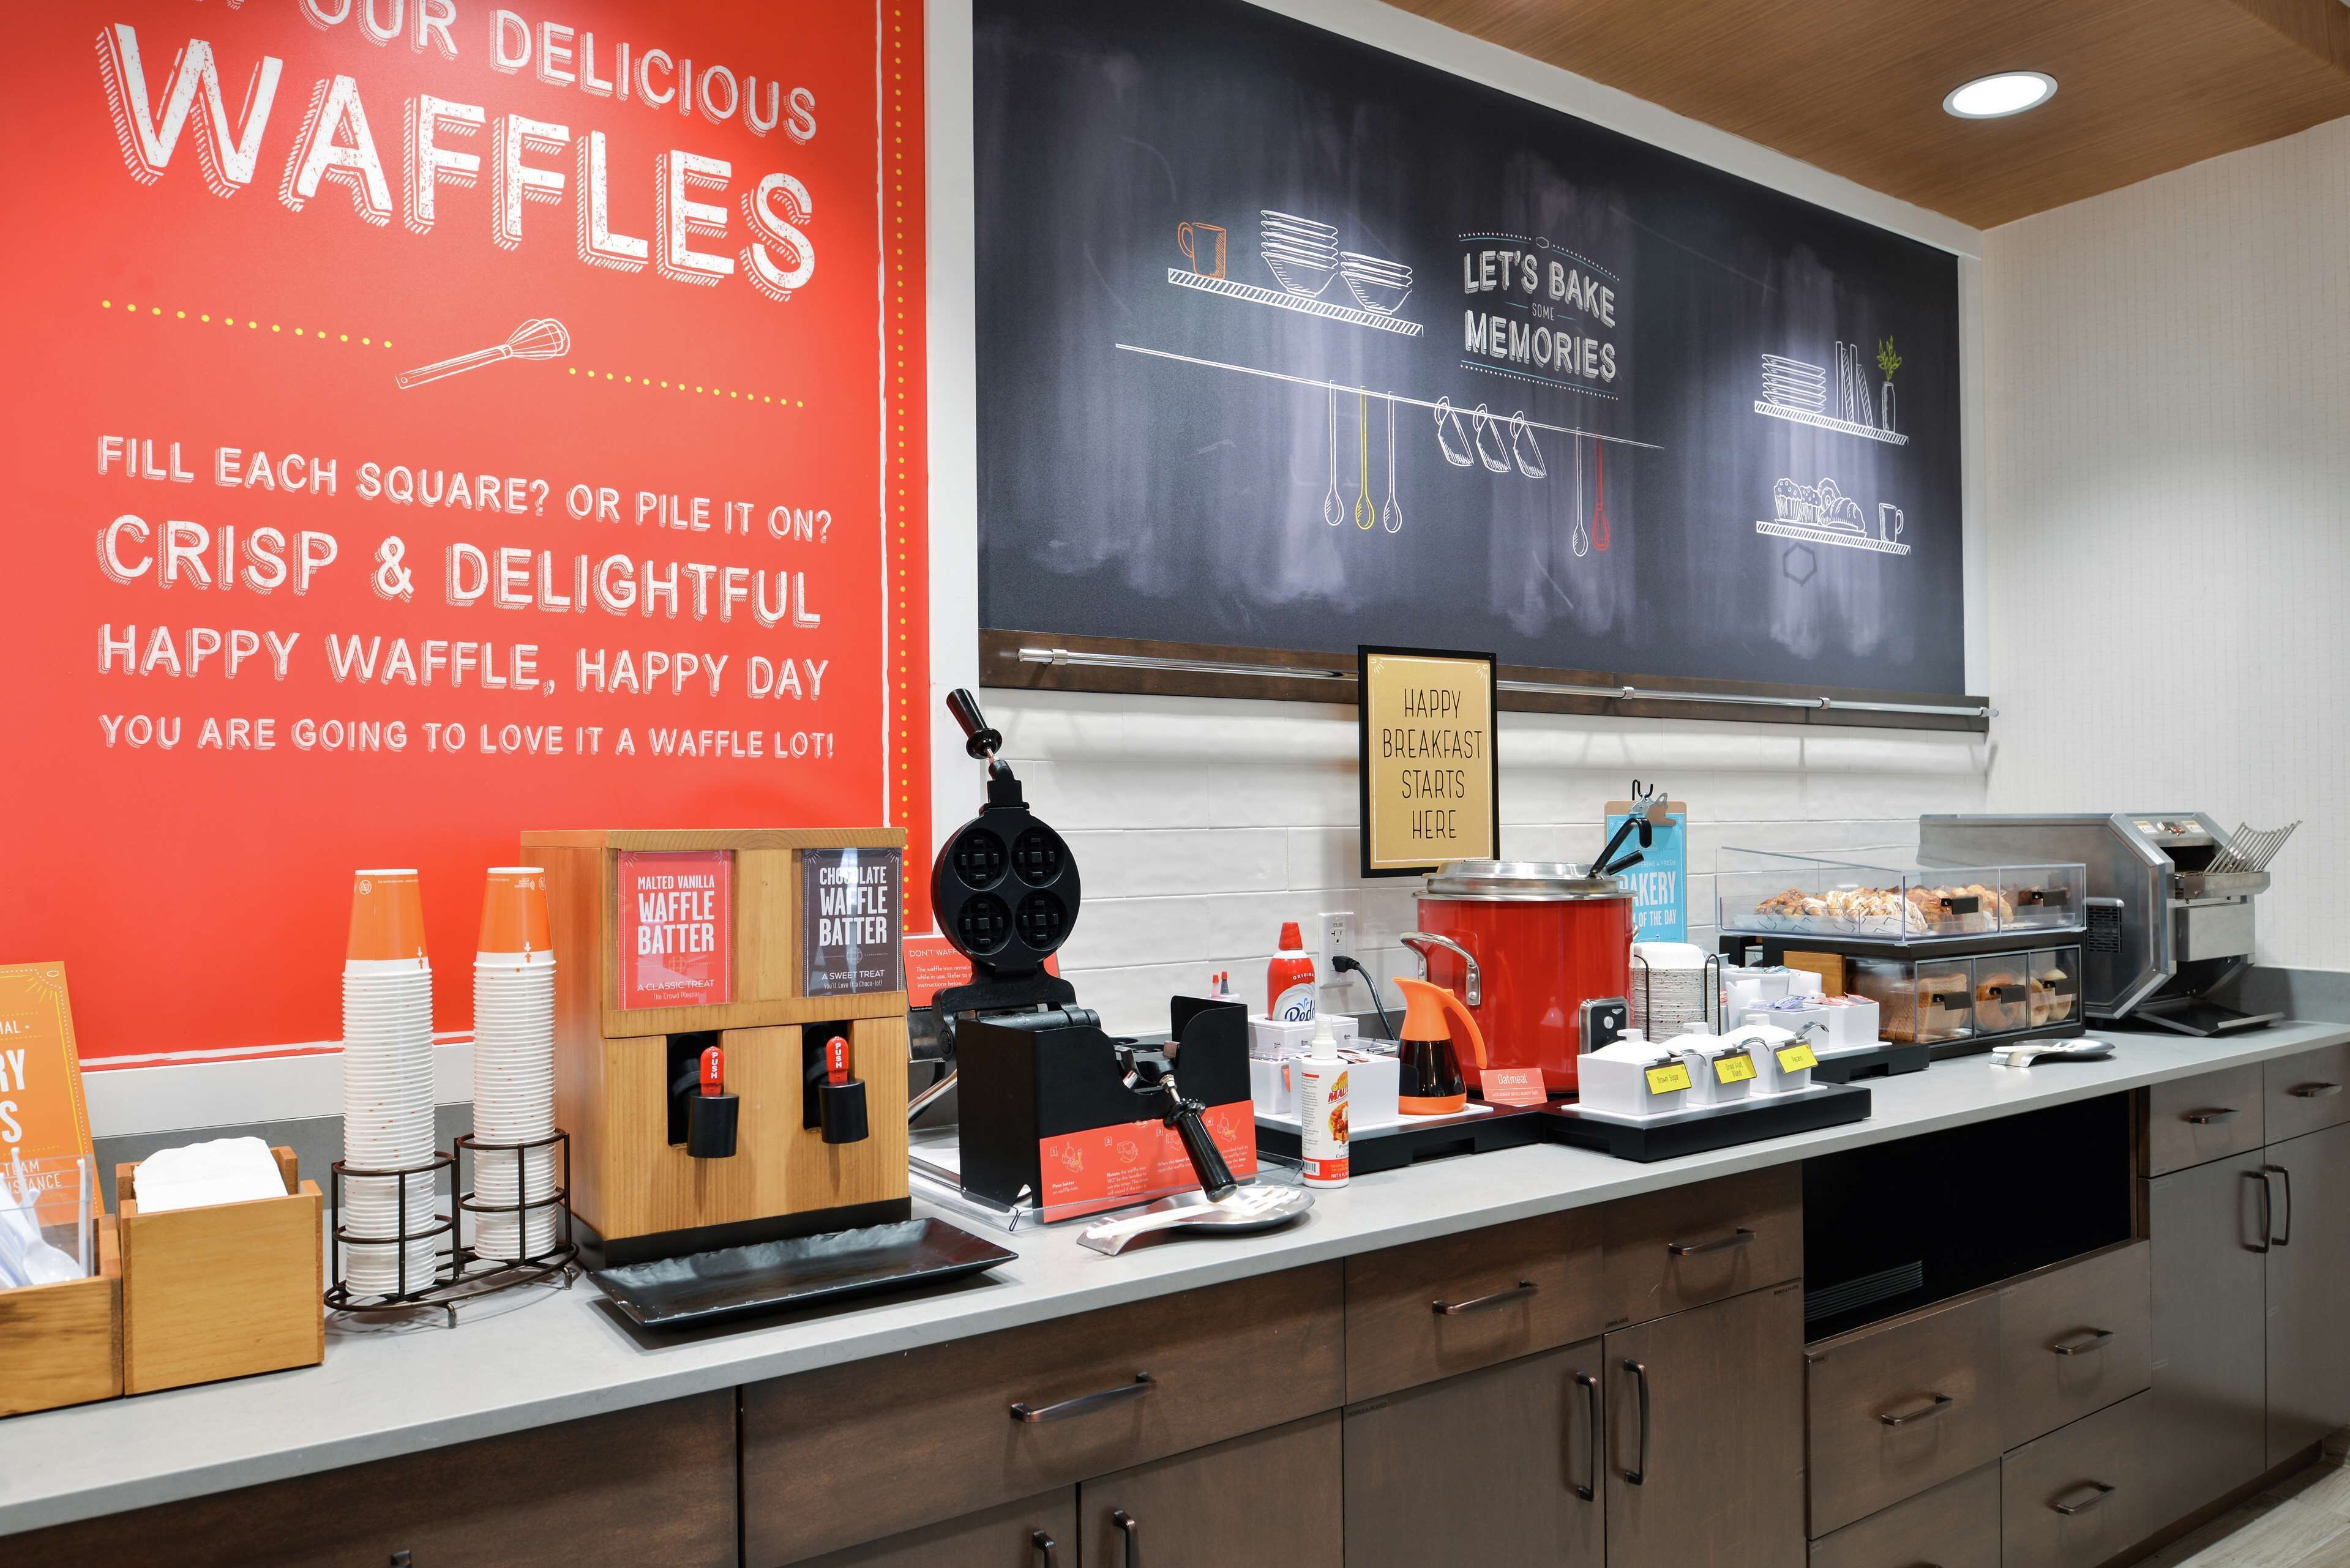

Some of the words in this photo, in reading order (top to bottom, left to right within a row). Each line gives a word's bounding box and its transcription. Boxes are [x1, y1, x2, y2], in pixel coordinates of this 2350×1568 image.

[490, 10, 816, 144] DELICIOUS
[96, 23, 816, 301] WAFFLES
[1464, 250, 1538, 294] LET'S
[1549, 261, 1615, 328] BAKE
[1532, 303, 1555, 321] SOME
[1465, 310, 1616, 382] MEMORIES
[98, 435, 194, 482] FILL
[215, 447, 336, 495] EACH
[356, 462, 549, 515] SQUARE?
[566, 484, 620, 523] OR
[636, 491, 710, 531] PILE
[725, 501, 754, 535] IT
[768, 506, 831, 543] ON?
[97, 515, 337, 596] CRISP
[372, 536, 414, 602] &
[446, 543, 820, 629] DELIGHTFUL
[98, 624, 300, 681] HAPPY
[325, 634, 555, 697] WAFFLE,
[577, 648, 728, 696] HAPPY
[747, 656, 828, 700] DAY
[1404, 689, 1461, 719] HAPPY
[99, 715, 181, 750] YOU
[198, 718, 275, 750] ARE
[291, 719, 406, 752] GOING
[422, 723, 465, 753] TO
[481, 725, 563, 754] LOVE
[577, 727, 603, 755] IT
[615, 728, 635, 755] A
[649, 728, 763, 758] WAFFLE
[775, 731, 833, 758] LOT!
[1383, 729, 1482, 758] BREAKFAST
[1402, 770, 1465, 798] STARTS
[1412, 810, 1457, 839] HERE
[638, 876, 674, 889] MALTED
[678, 875, 714, 889] VANILLA
[638, 891, 714, 922] WAFFLE
[820, 886, 888, 916] WAFFLE
[820, 916, 886, 946] BATTER
[1639, 911, 1647, 927] OF
[1649, 910, 1662, 926] THE
[1664, 909, 1676, 925] DAY
[638, 923, 714, 955] BATTER
[646, 981, 685, 991] CLASSIC
[686, 979, 715, 988] TREAT
[1498, 1073, 1528, 1085] Oatmeal
